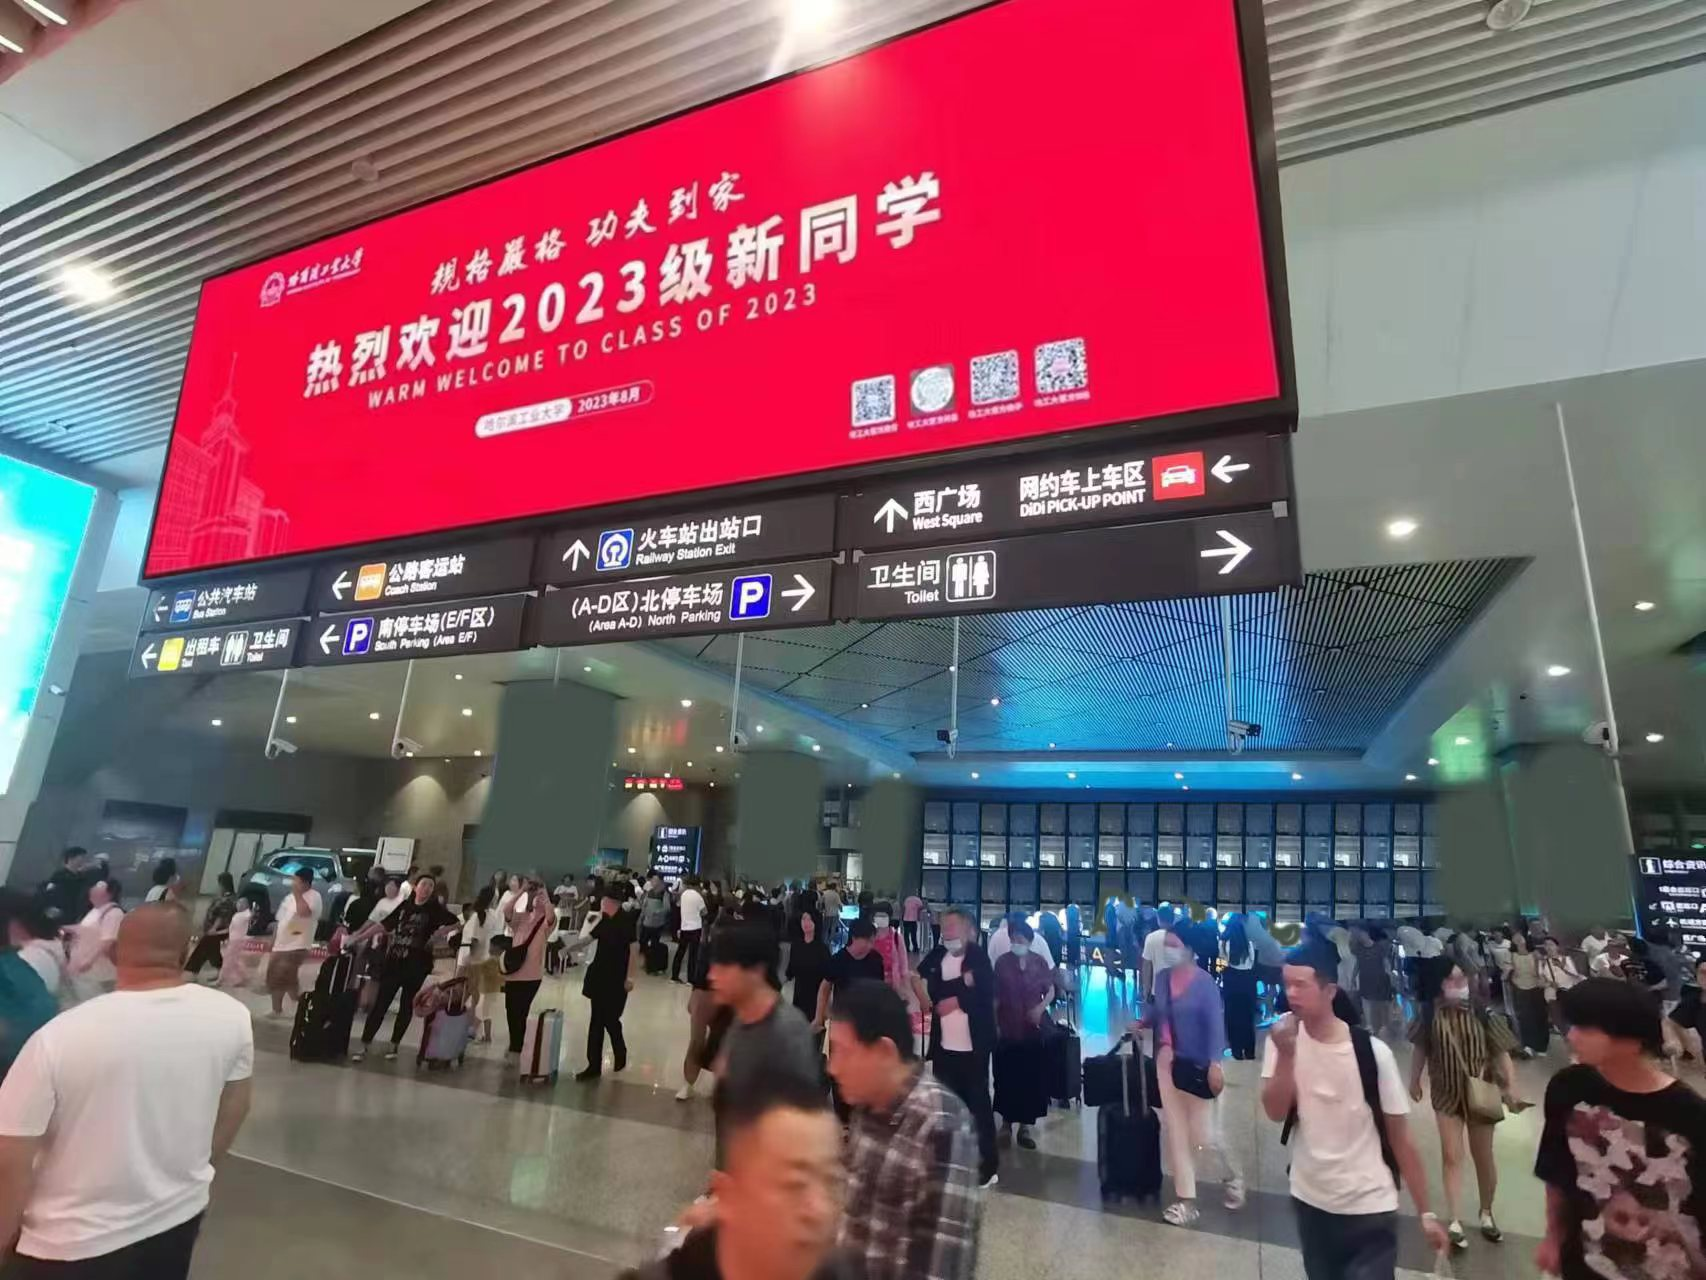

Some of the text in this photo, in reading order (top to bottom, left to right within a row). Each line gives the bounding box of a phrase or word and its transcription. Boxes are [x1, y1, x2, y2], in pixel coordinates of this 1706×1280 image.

[585, 170, 746, 248] 功夫到家
[303, 171, 941, 399] 热烈欢迎2023级新同学
[367, 283, 818, 409] WARM WELCOME TO CLASS OF 2023
[577, 385, 641, 414] 2023年8月
[1018, 459, 1146, 502] 网约车上车区
[913, 483, 981, 516] 西广场
[1019, 488, 1147, 518] DiDi PICK-UP POINT
[636, 514, 763, 552] 火车站出站口
[912, 509, 983, 531] West Square
[388, 553, 466, 584] 公路客运站
[635, 542, 736, 566] Railway Station Exit
[384, 581, 438, 597] Coach Station
[867, 558, 941, 590] 卫生间
[197, 583, 258, 607] 公共汽车站
[570, 582, 724, 619] (A-D区)北停车场
[905, 589, 940, 605] Toilet
[378, 605, 495, 638] 南停车场(E/F区)
[589, 608, 721, 633] (Area A-D) North Parking
[184, 636, 221, 657] 出租车
[248, 628, 290, 650] 卫生间
[375, 641, 397, 652] South
[399, 637, 430, 650] Parking
